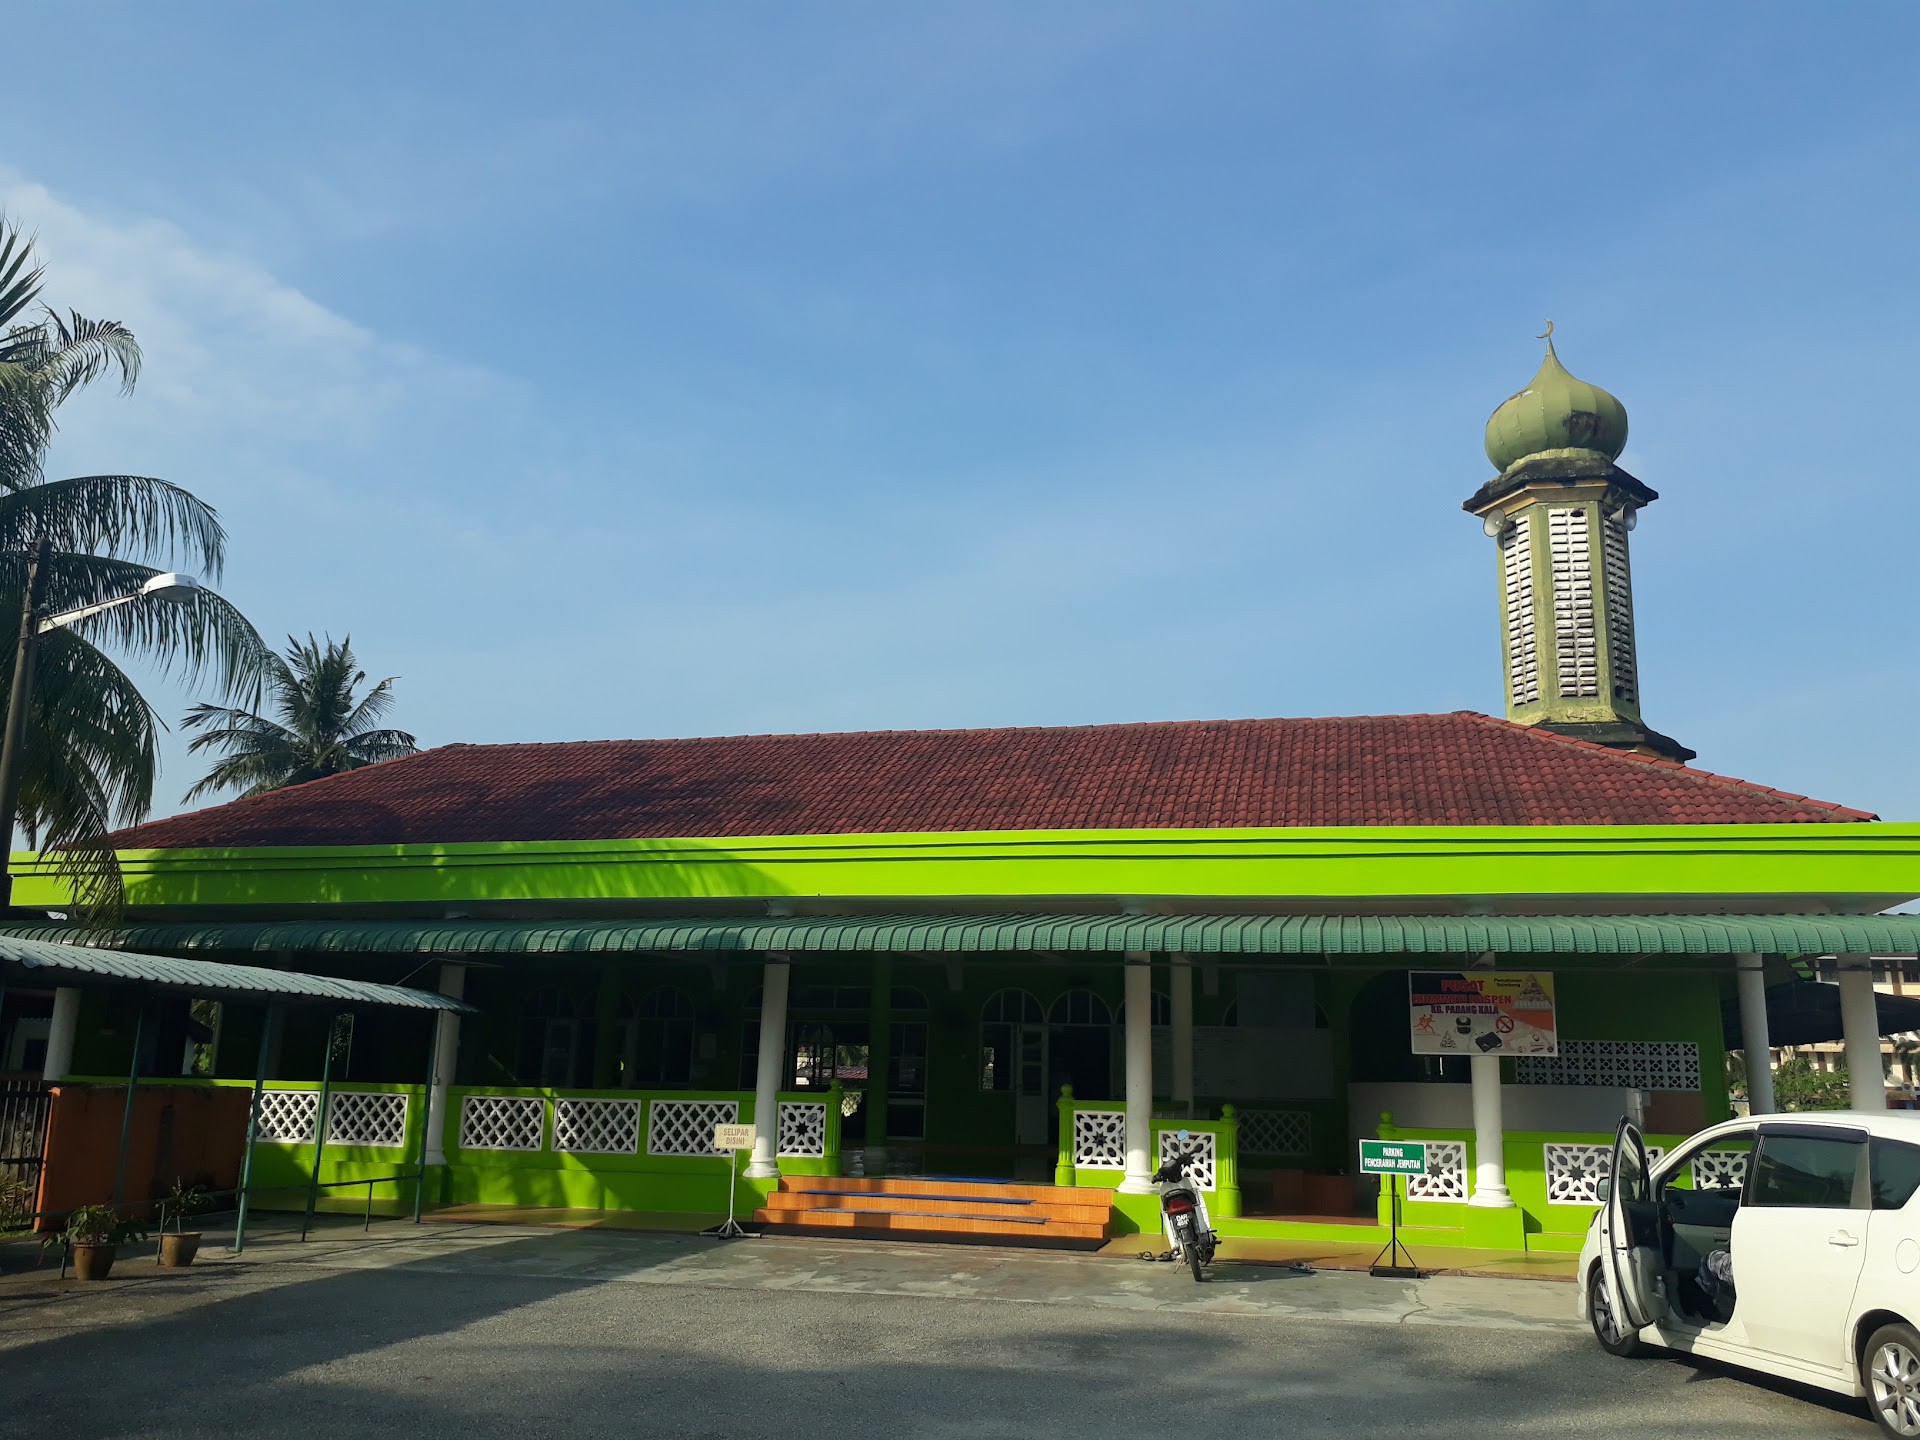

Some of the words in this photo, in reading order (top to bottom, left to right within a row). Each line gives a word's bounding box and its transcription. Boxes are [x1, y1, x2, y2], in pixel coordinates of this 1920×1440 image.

[1441, 980, 1484, 992] PUSAT
[1431, 1005, 1444, 1014] KG.
[1446, 1006, 1477, 1014] PADANG
[726, 1137, 745, 1145] DISINI
[1382, 1147, 1404, 1157] PARKING
[1364, 1158, 1396, 1168] PENCERAMAH
[1397, 1159, 1420, 1169] JEMPUTAN
